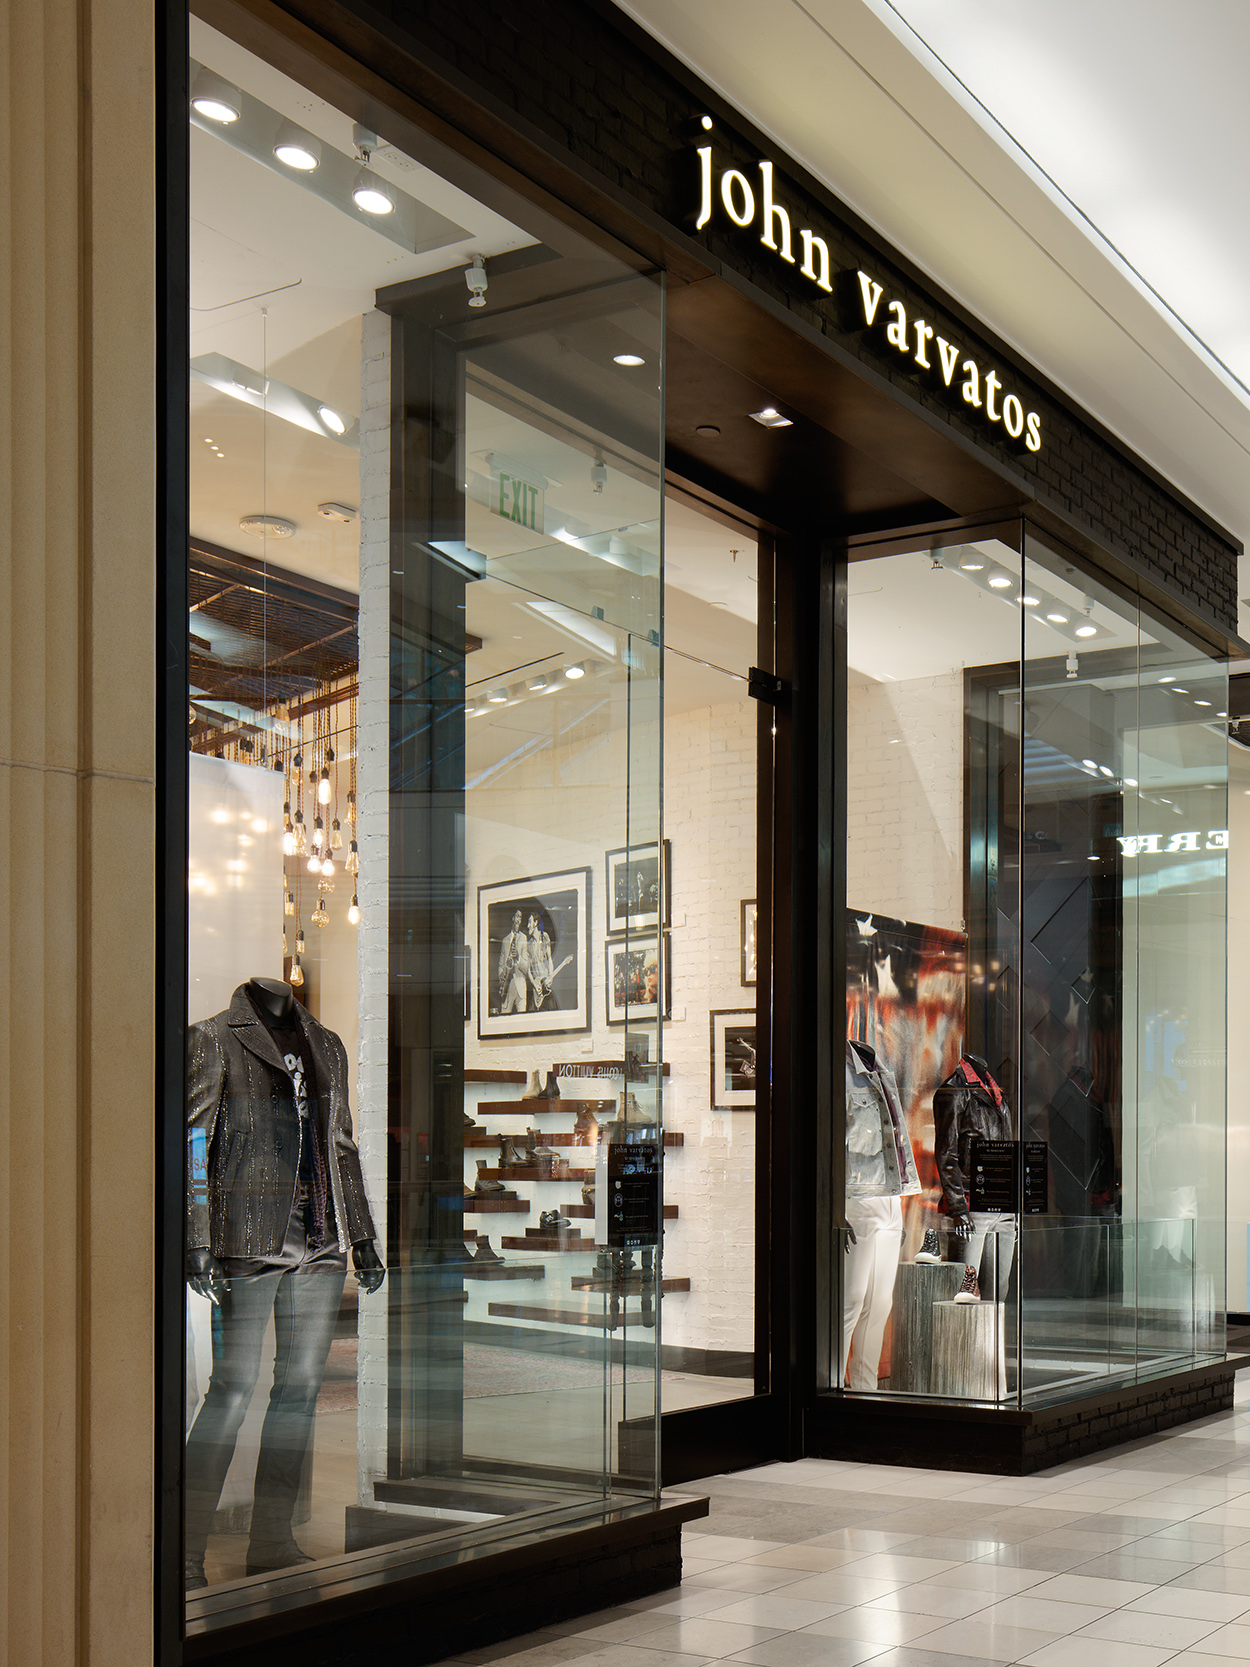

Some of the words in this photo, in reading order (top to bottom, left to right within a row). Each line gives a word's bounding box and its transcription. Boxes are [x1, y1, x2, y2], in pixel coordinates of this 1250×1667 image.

[696, 115, 833, 292] john
[857, 270, 1042, 452] varvatos
[500, 473, 539, 530] EXIT
